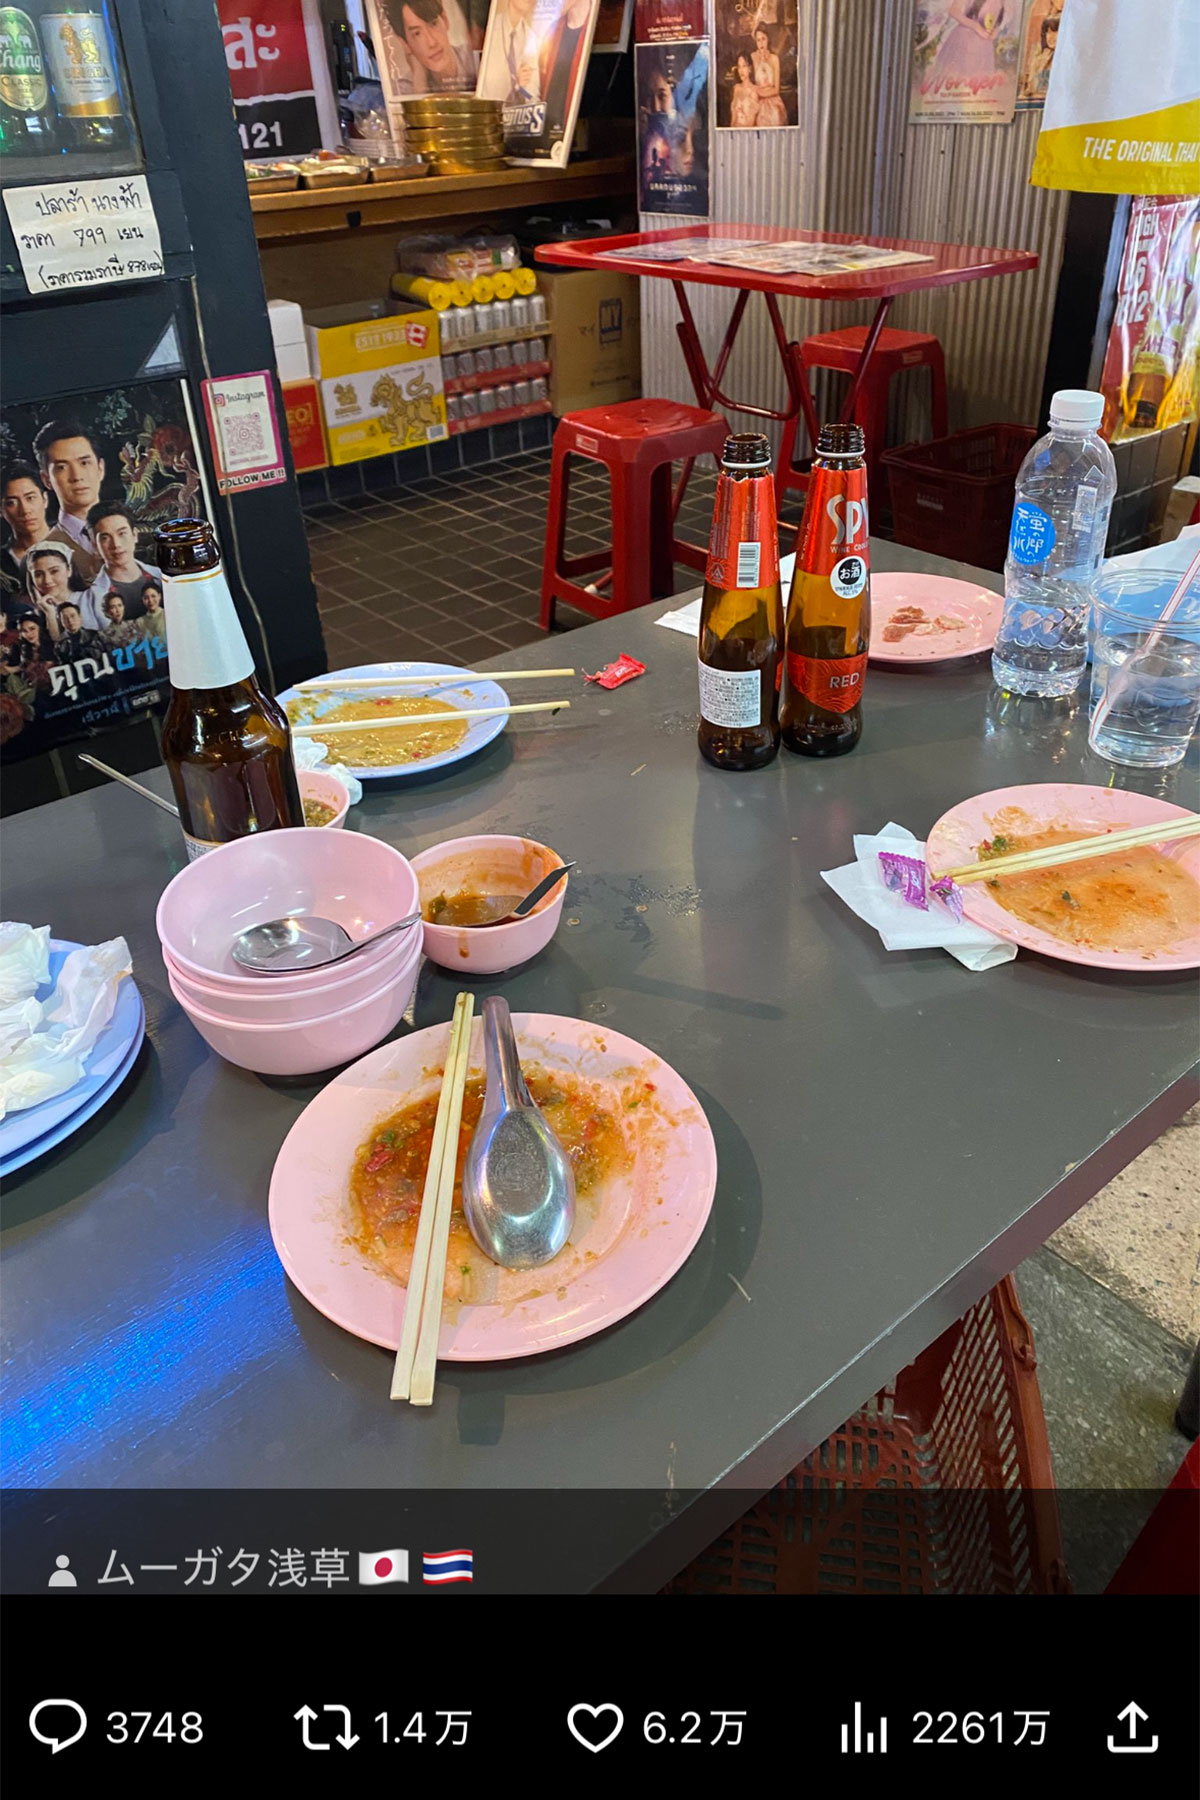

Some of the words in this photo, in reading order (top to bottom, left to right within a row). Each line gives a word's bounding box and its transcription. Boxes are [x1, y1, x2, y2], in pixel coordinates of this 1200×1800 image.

[0, 49, 41, 73] hang
[1083, 136, 1116, 160] THE
[1117, 140, 1174, 162] ORIGINAL
[73, 227, 107, 247] 799
[226, 391, 265, 403] Instagram
[219, 473, 259, 489] FOLLOW
[262, 470, 276, 480] ME
[839, 564, 861, 580] お酒
[829, 672, 860, 689] RED
